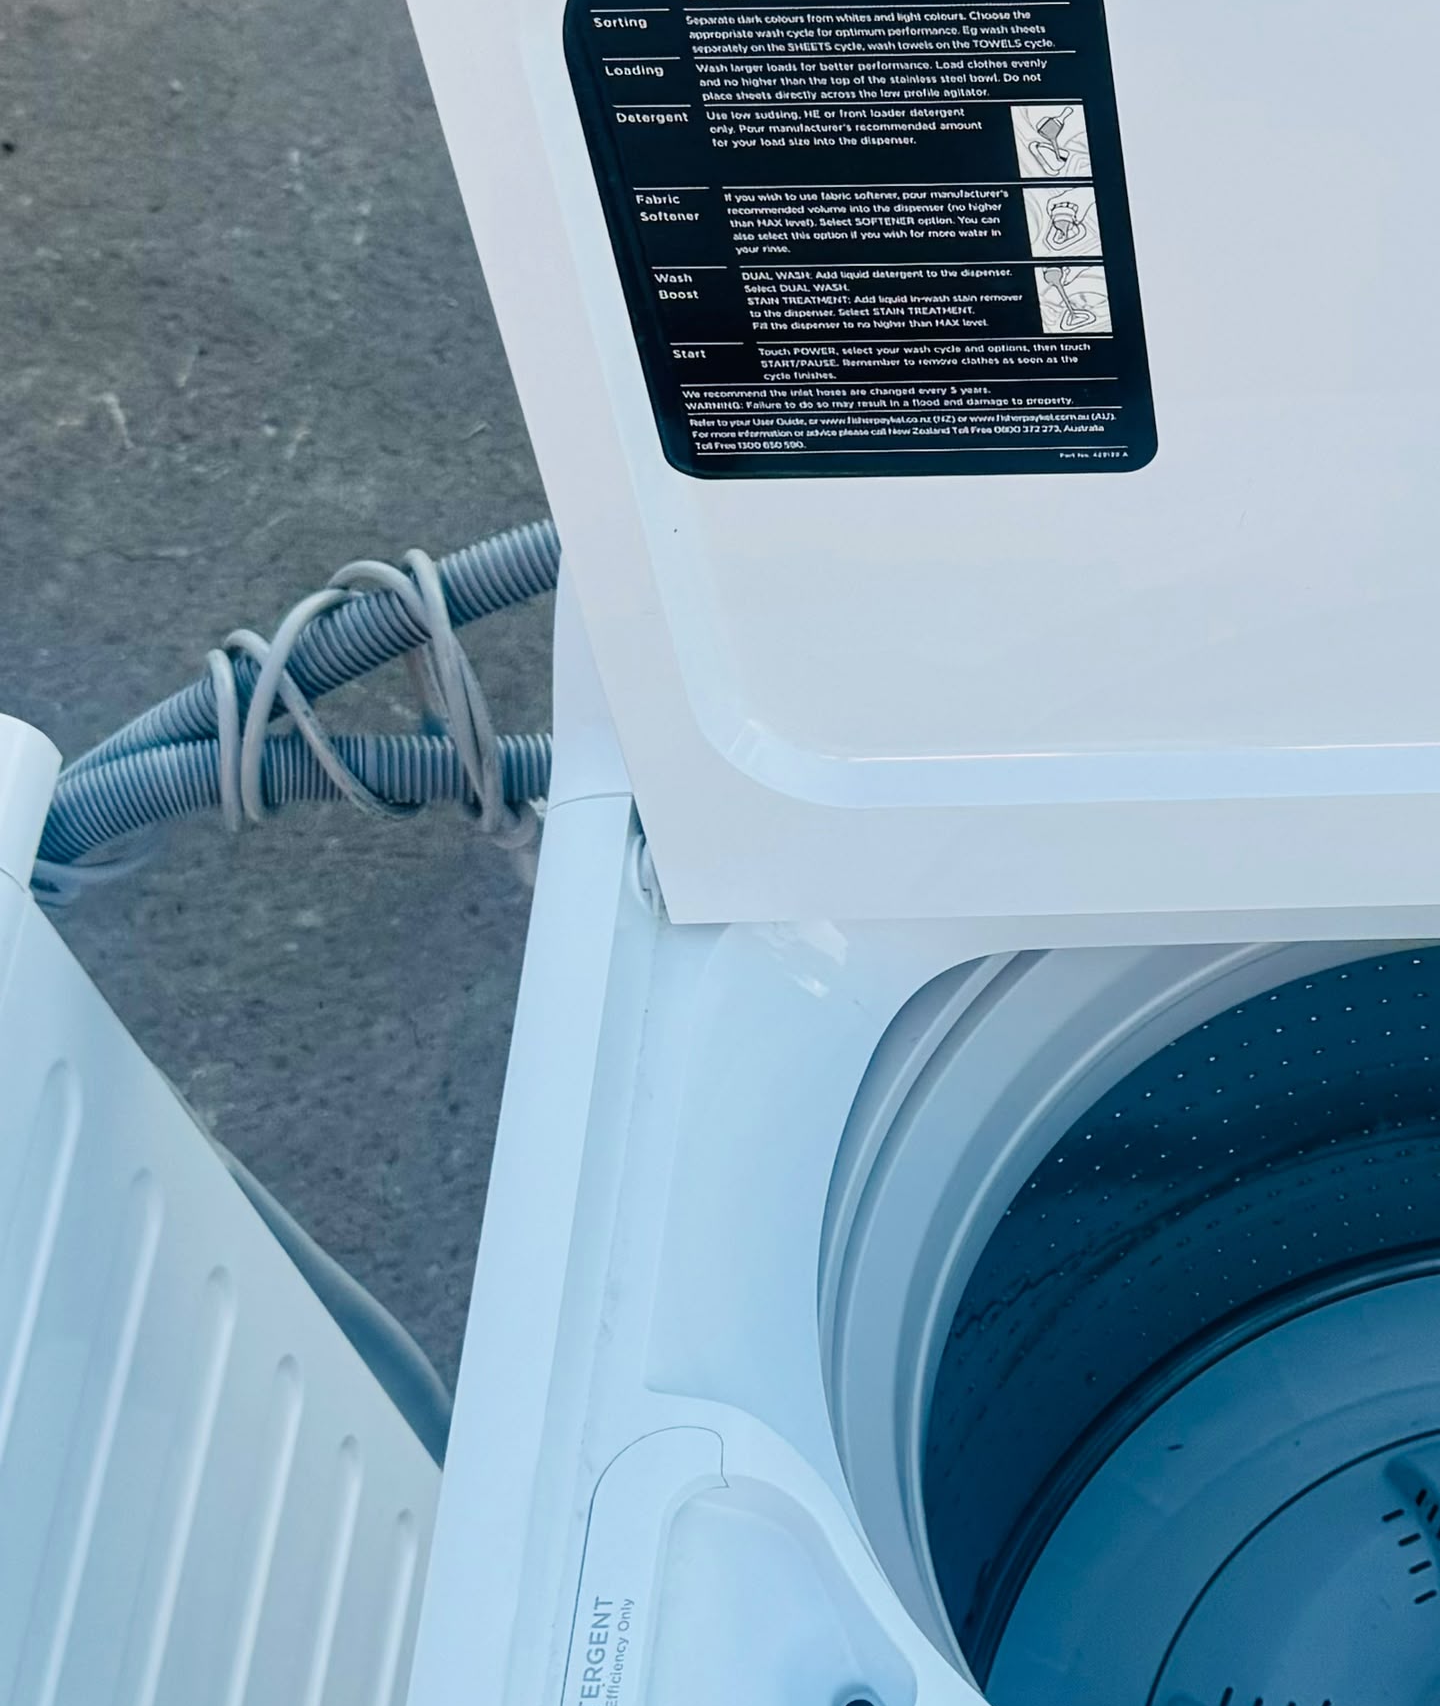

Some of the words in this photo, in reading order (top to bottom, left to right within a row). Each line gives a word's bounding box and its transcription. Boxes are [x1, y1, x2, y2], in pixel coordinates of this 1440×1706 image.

[592, 16, 648, 29] Sorting
[688, 29, 754, 41] appropriate
[754, 28, 785, 38] wash
[785, 27, 815, 39] cycle
[816, 27, 833, 37] for
[834, 27, 886, 38] optimum
[961, 24, 978, 36] Eg
[979, 24, 1009, 35] wash
[1009, 24, 1046, 34] sheets
[604, 64, 664, 77] Loading
[694, 63, 729, 73] Wash
[729, 63, 763, 74] larger
[765, 62, 798, 72] loads
[799, 61, 816, 72] for
[818, 61, 854, 71] better
[934, 59, 964, 70] Load
[966, 59, 1008, 69] clothes
[1010, 57, 1048, 69] evenly
[699, 77, 721, 87] and
[723, 78, 739, 87] no
[740, 76, 777, 88] higher
[779, 76, 807, 86] than
[807, 76, 828, 86] the
[829, 76, 851, 86] top
[852, 74, 865, 85] of
[867, 74, 887, 85] the
[889, 74, 937, 84] stainless
[939, 73, 967, 84] steel
[1002, 72, 1020, 83] Do
[1022, 72, 1042, 82] not
[701, 91, 733, 102] place
[735, 90, 772, 101] sheets
[774, 89, 817, 101] directly
[820, 90, 857, 99] across
[857, 88, 878, 99] the
[879, 88, 901, 98] low
[902, 87, 940, 99] profile
[615, 111, 689, 125] Detergent
[705, 110, 728, 121] Use
[730, 110, 751, 120] low
[803, 109, 821, 119] HE
[823, 110, 836, 119] or
[838, 108, 867, 118] front
[869, 108, 906, 118] loader
[909, 107, 965, 118] detergent
[738, 123, 765, 134] Pour
[854, 121, 937, 132] recommended
[939, 120, 983, 130] amount
[711, 137, 728, 148] for
[731, 138, 757, 149] your
[759, 136, 786, 147] load
[787, 137, 811, 146] size
[812, 136, 836, 146] into
[837, 136, 858, 146] the
[635, 193, 681, 205] Fabric
[723, 192, 732, 202] If
[733, 194, 756, 203] you
[756, 192, 783, 202] wish
[784, 192, 797, 201] to
[798, 193, 818, 201] use
[820, 191, 852, 201] fabric
[901, 191, 927, 200] pour
[726, 204, 805, 215] recommended
[806, 204, 847, 214] volume
[848, 204, 871, 213] into
[872, 204, 891, 213] the
[892, 203, 944, 213] dispenser
[967, 202, 1002, 213] higher
[639, 210, 700, 222] Softener
[729, 219, 755, 228] than
[756, 218, 783, 228] MAX
[818, 217, 853, 227] Select
[854, 216, 915, 226] SOFTENER
[956, 215, 978, 224] You
[980, 216, 1001, 224] can
[732, 232, 755, 241] also
[757, 231, 789, 241] select
[790, 231, 811, 240] this
[812, 231, 849, 241] option
[849, 229, 858, 239] if
[859, 231, 881, 240] you
[882, 229, 908, 239] wish
[909, 228, 925, 238] for
[927, 229, 956, 238] more
[957, 228, 988, 237] water
[990, 228, 1002, 237] in
[734, 245, 760, 255] your
[653, 272, 693, 283] Wash
[657, 289, 699, 300] Boost
[748, 309, 762, 318] to
[762, 308, 782, 318] the
[837, 307, 870, 317] Select
[872, 306, 905, 316] STAIN
[671, 348, 707, 359] Start
[757, 347, 791, 357] Touch
[841, 346, 873, 355] select
[875, 346, 900, 356] your
[902, 344, 931, 354] wash
[933, 344, 962, 355] cycle
[964, 344, 985, 353] and
[1032, 343, 1058, 352] then
[1059, 342, 1091, 351] touch
[681, 389, 701, 399] We
[702, 389, 767, 398] recommend
[768, 388, 788, 398] the
[789, 388, 814, 397] inlet
[815, 387, 847, 397] hoses
[849, 388, 867, 396] are
[869, 386, 916, 397] changed
[917, 387, 947, 396] every
[949, 385, 958, 394] 5
[617, 1598, 635, 1632] Only
